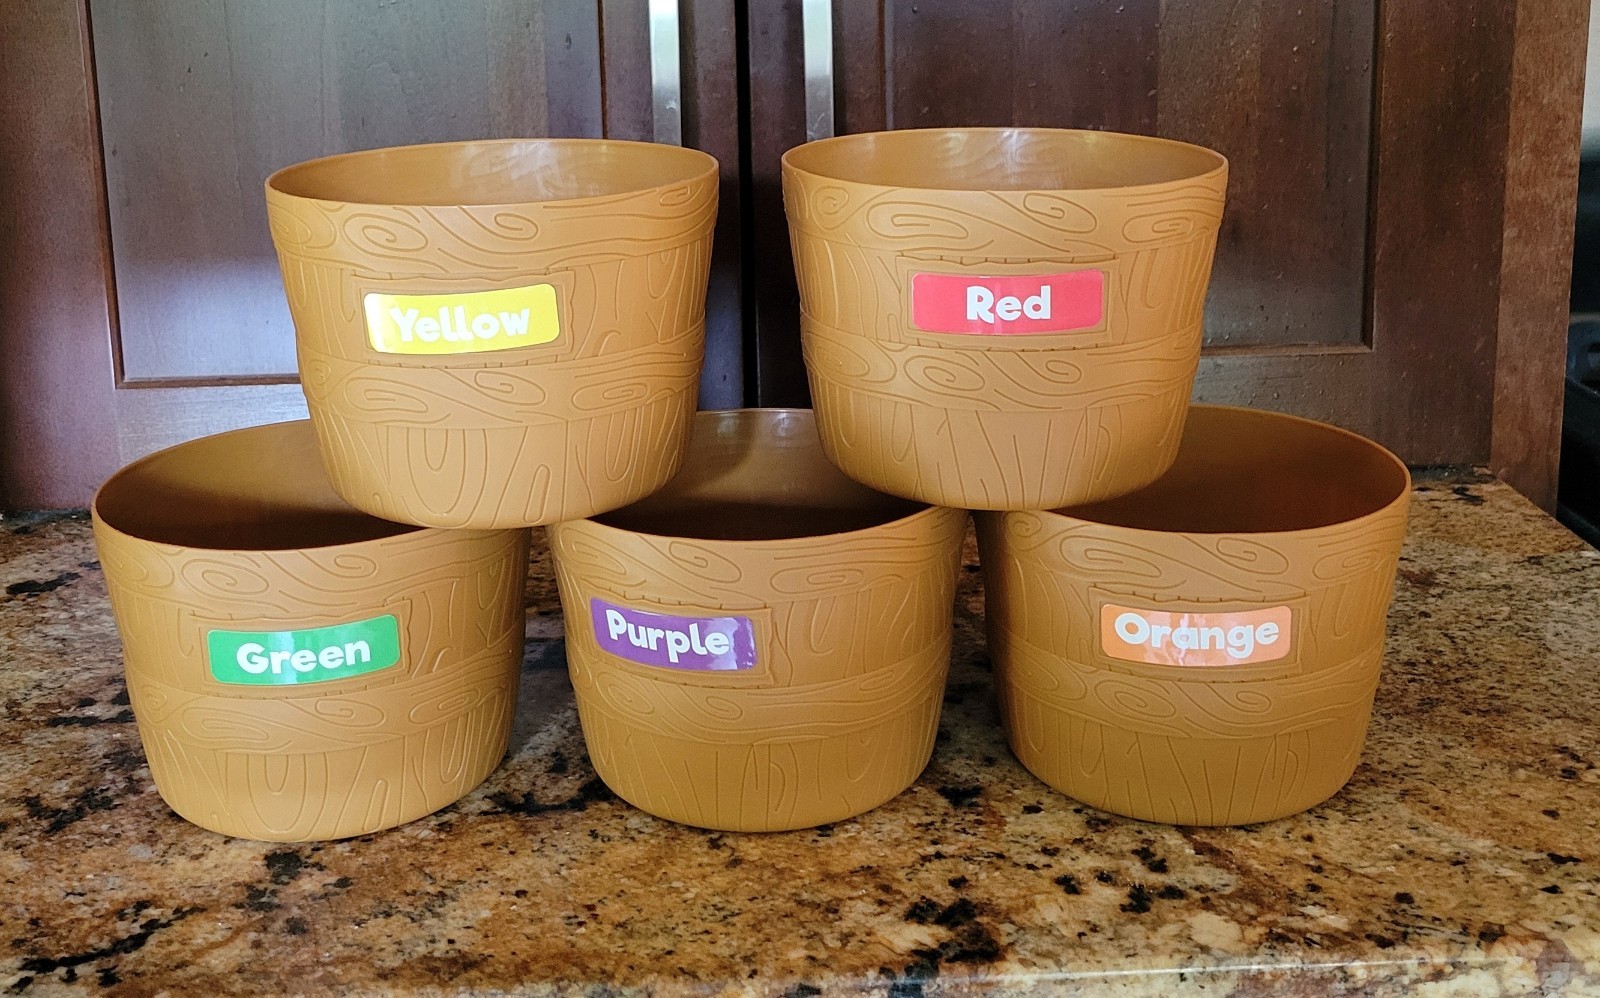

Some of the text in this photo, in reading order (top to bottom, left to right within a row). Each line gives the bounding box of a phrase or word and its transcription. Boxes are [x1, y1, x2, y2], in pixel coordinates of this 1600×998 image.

[390, 306, 530, 342] Yellow
[966, 285, 1051, 324] Red
[607, 609, 730, 663] Purple
[1114, 612, 1279, 659] Orange
[236, 638, 371, 674] Green
